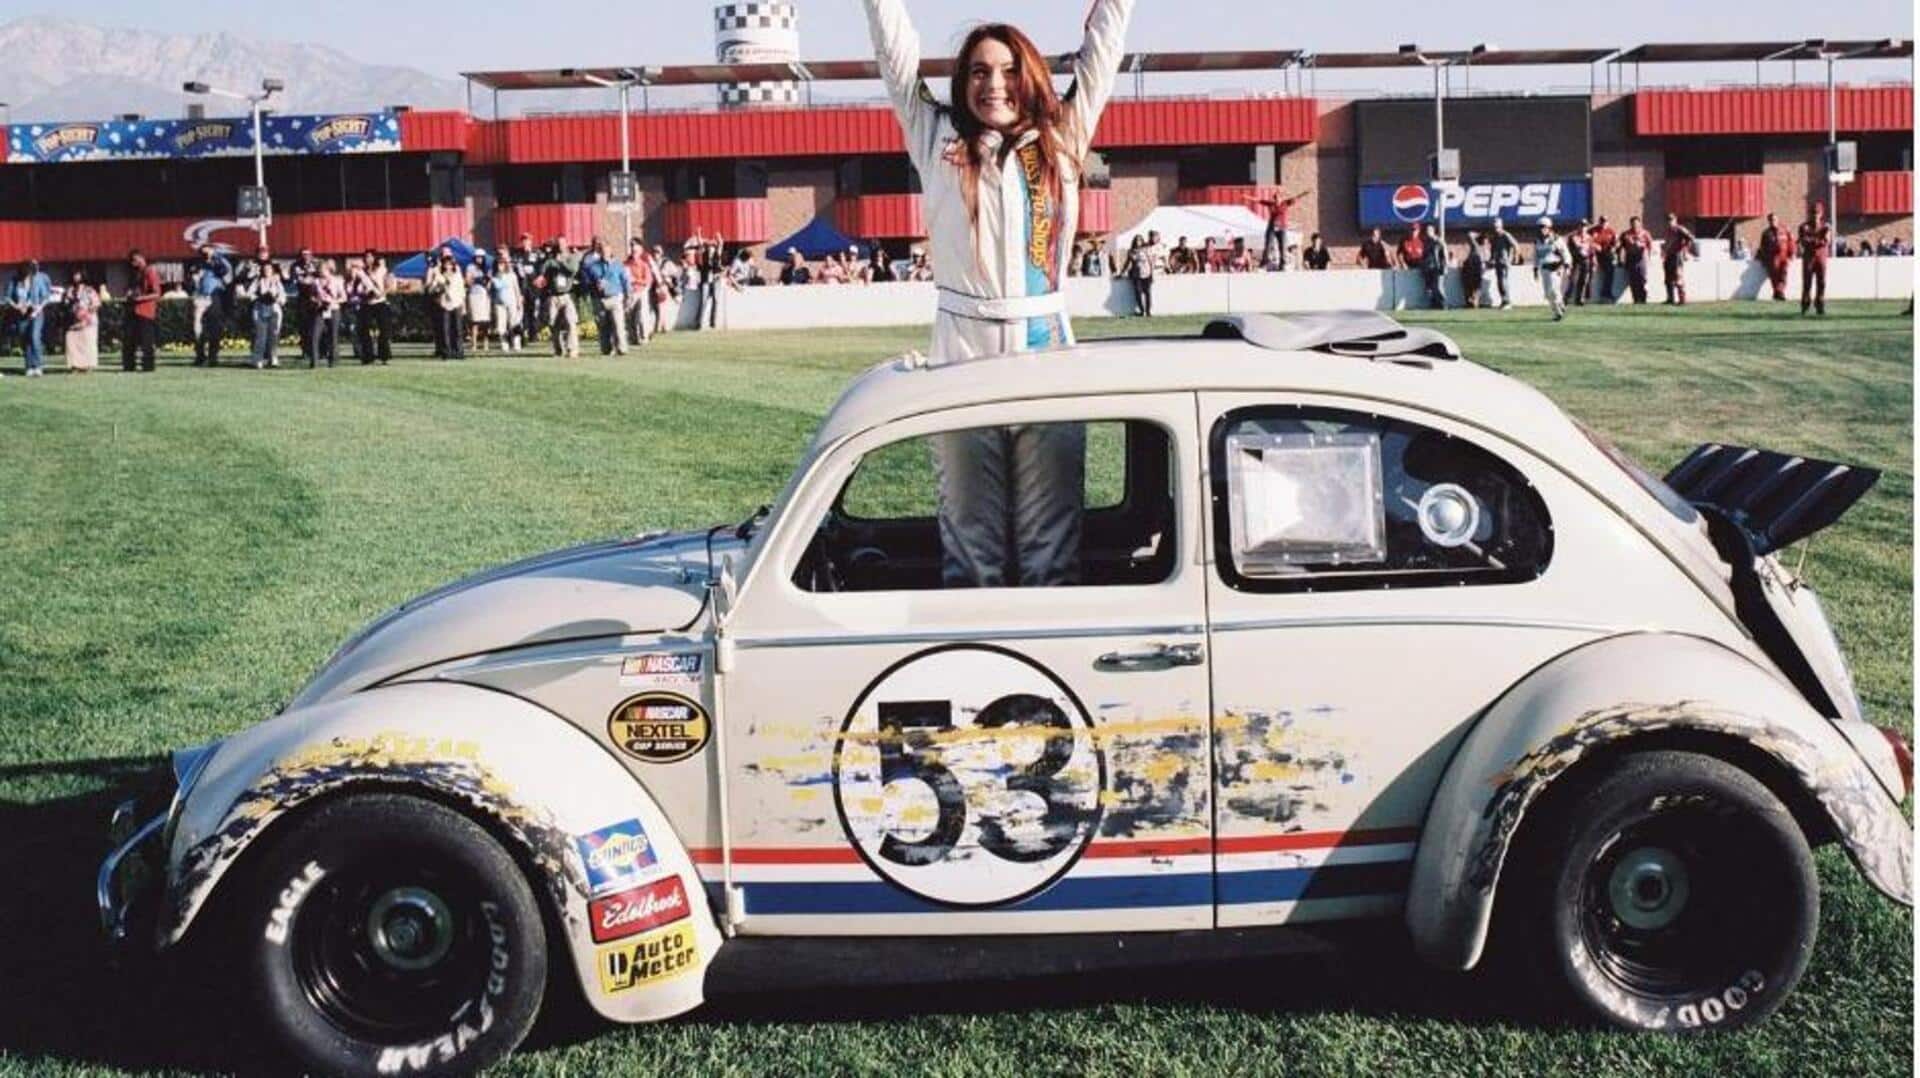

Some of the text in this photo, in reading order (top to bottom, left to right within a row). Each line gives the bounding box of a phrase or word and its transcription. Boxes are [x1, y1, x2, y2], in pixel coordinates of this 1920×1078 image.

[1434, 183, 1562, 217] PEPSI
[1030, 216, 1051, 267] Shops
[645, 656, 697, 673] NASCAR
[626, 723, 692, 738] NEXTEL
[878, 693, 1075, 867] 53
[264, 860, 326, 945] EAGLE
[629, 946, 695, 984] Meter
[633, 932, 684, 963] Auto
